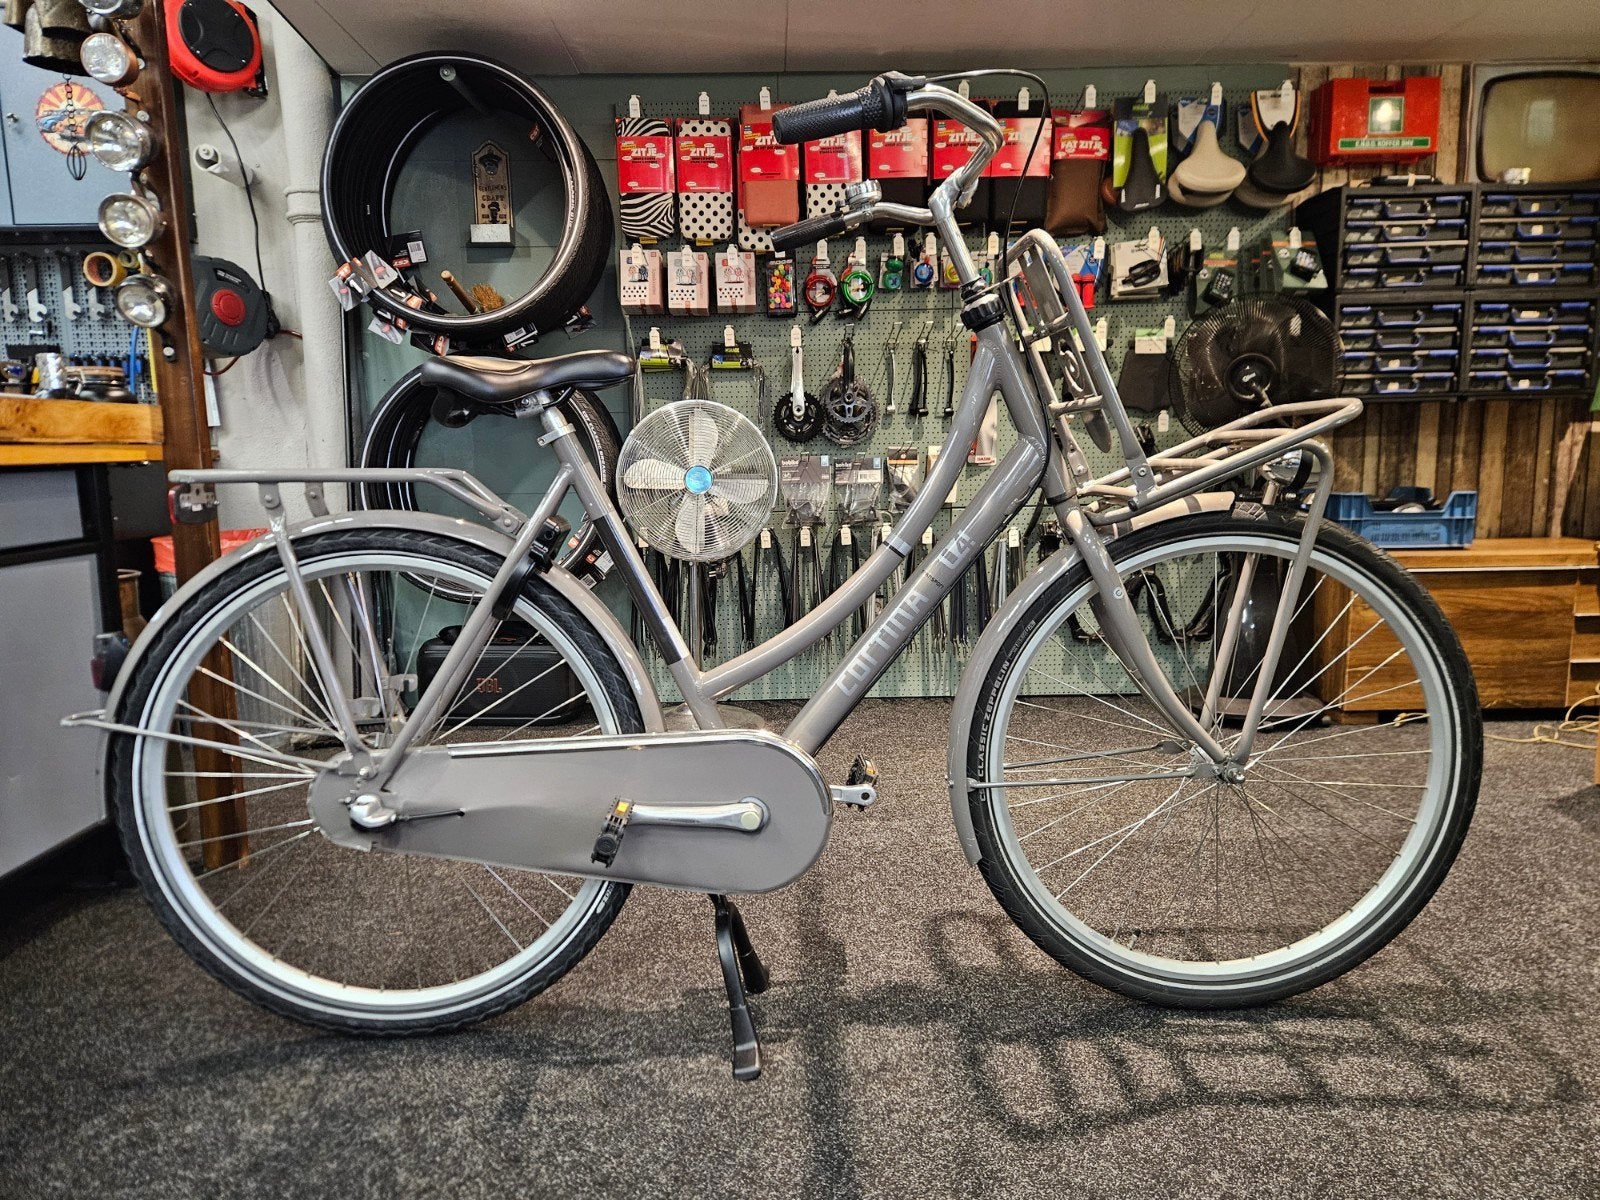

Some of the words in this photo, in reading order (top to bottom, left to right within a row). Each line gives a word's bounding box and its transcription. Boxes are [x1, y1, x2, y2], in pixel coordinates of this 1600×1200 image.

[755, 135, 778, 146] ZITJ
[884, 132, 913, 143] ZITJE
[631, 147, 658, 157] ZITJE
[690, 147, 716, 157] ZITJE
[836, 590, 930, 697] CORTINA
[476, 677, 503, 694] JBL
[977, 723, 989, 778] CLASSIC
[984, 660, 1010, 720] ZEPPELIN
